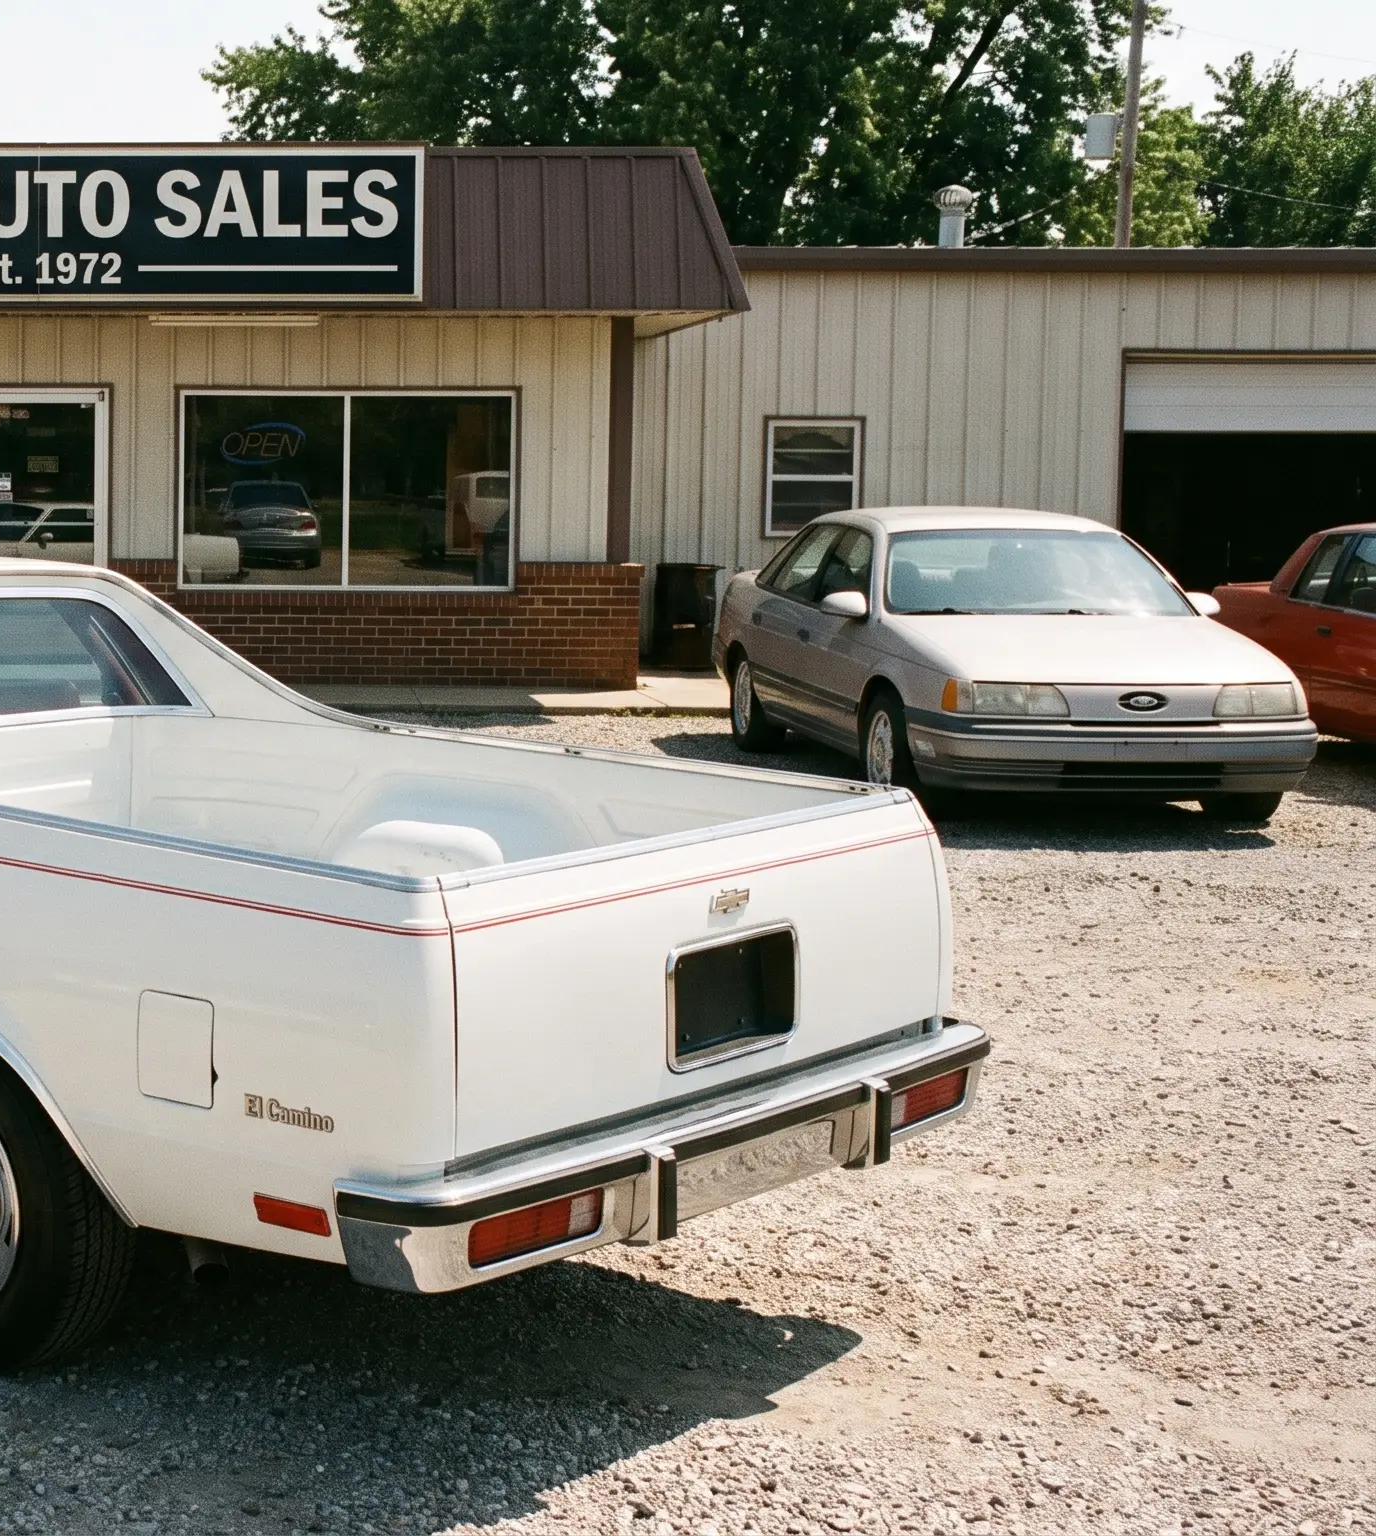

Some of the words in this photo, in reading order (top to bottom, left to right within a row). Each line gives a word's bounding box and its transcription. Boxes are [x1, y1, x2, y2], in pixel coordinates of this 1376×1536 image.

[154, 170, 399, 239] SALES
[35, 252, 122, 285] 1972
[222, 432, 301, 457] OPEN
[244, 1093, 264, 1119] El
[266, 1098, 335, 1133] Camino
